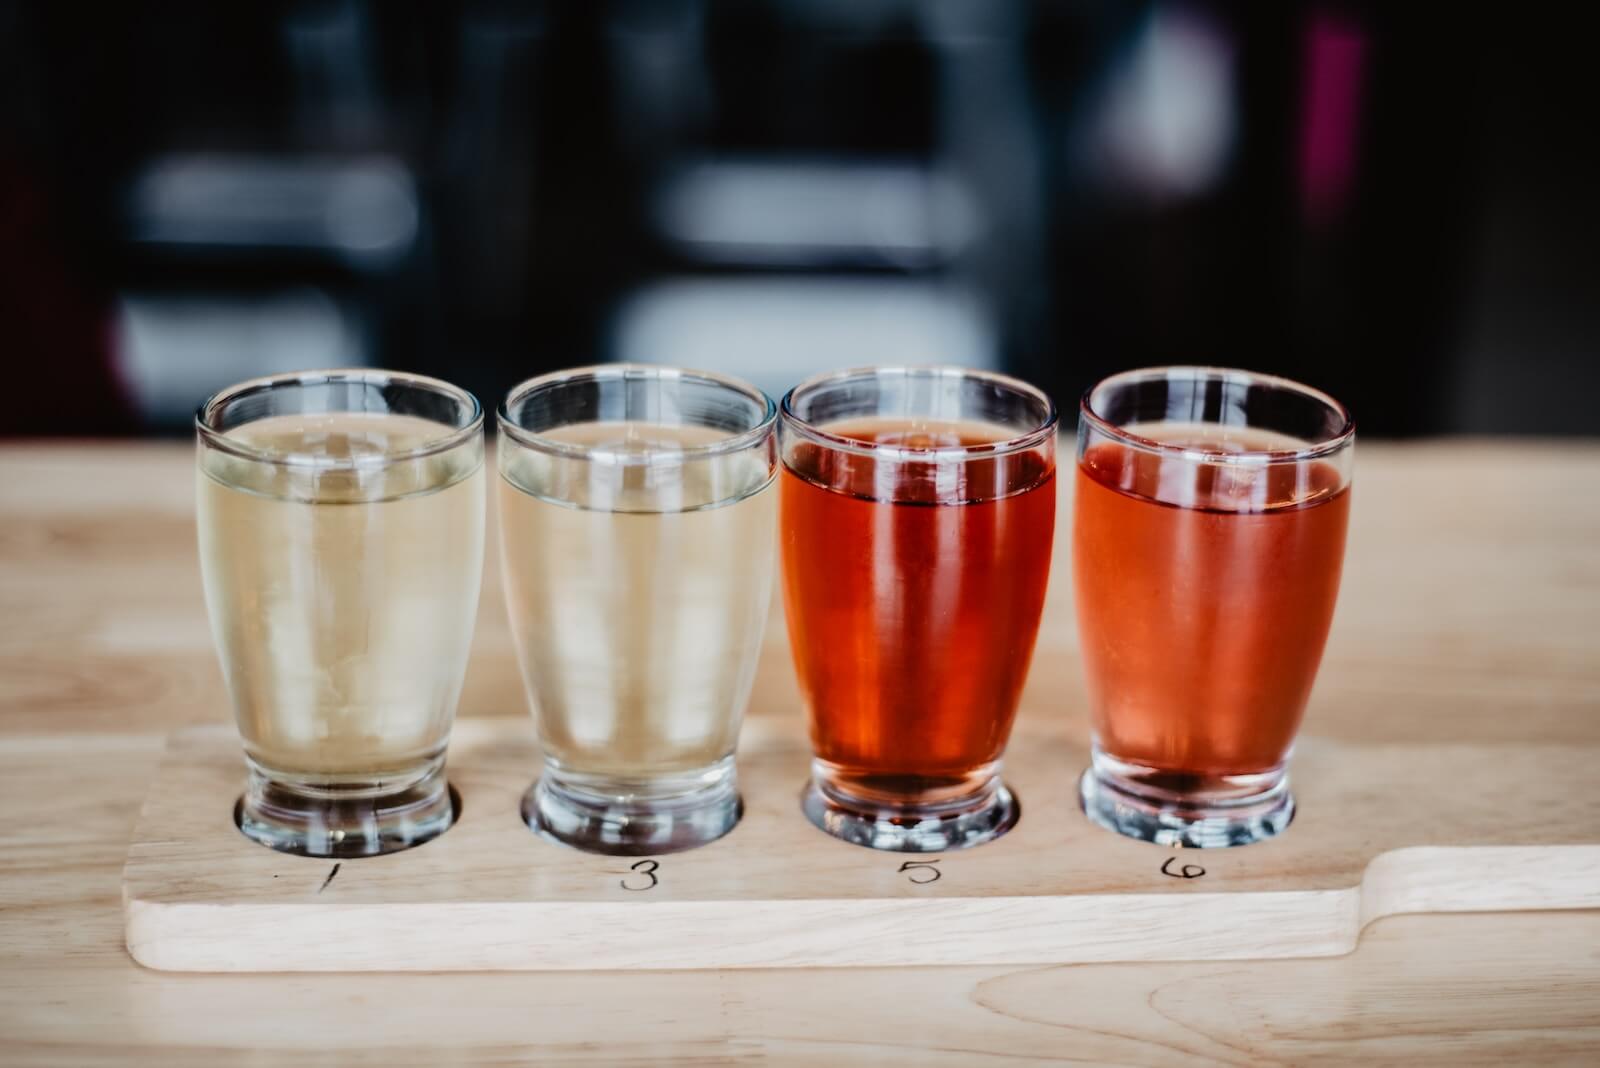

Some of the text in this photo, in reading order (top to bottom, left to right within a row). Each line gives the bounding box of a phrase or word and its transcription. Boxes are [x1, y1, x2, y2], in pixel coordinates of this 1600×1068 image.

[317, 862, 342, 894] 1
[620, 858, 661, 891] 3
[897, 858, 942, 884] 5
[1160, 856, 1207, 879] 6
